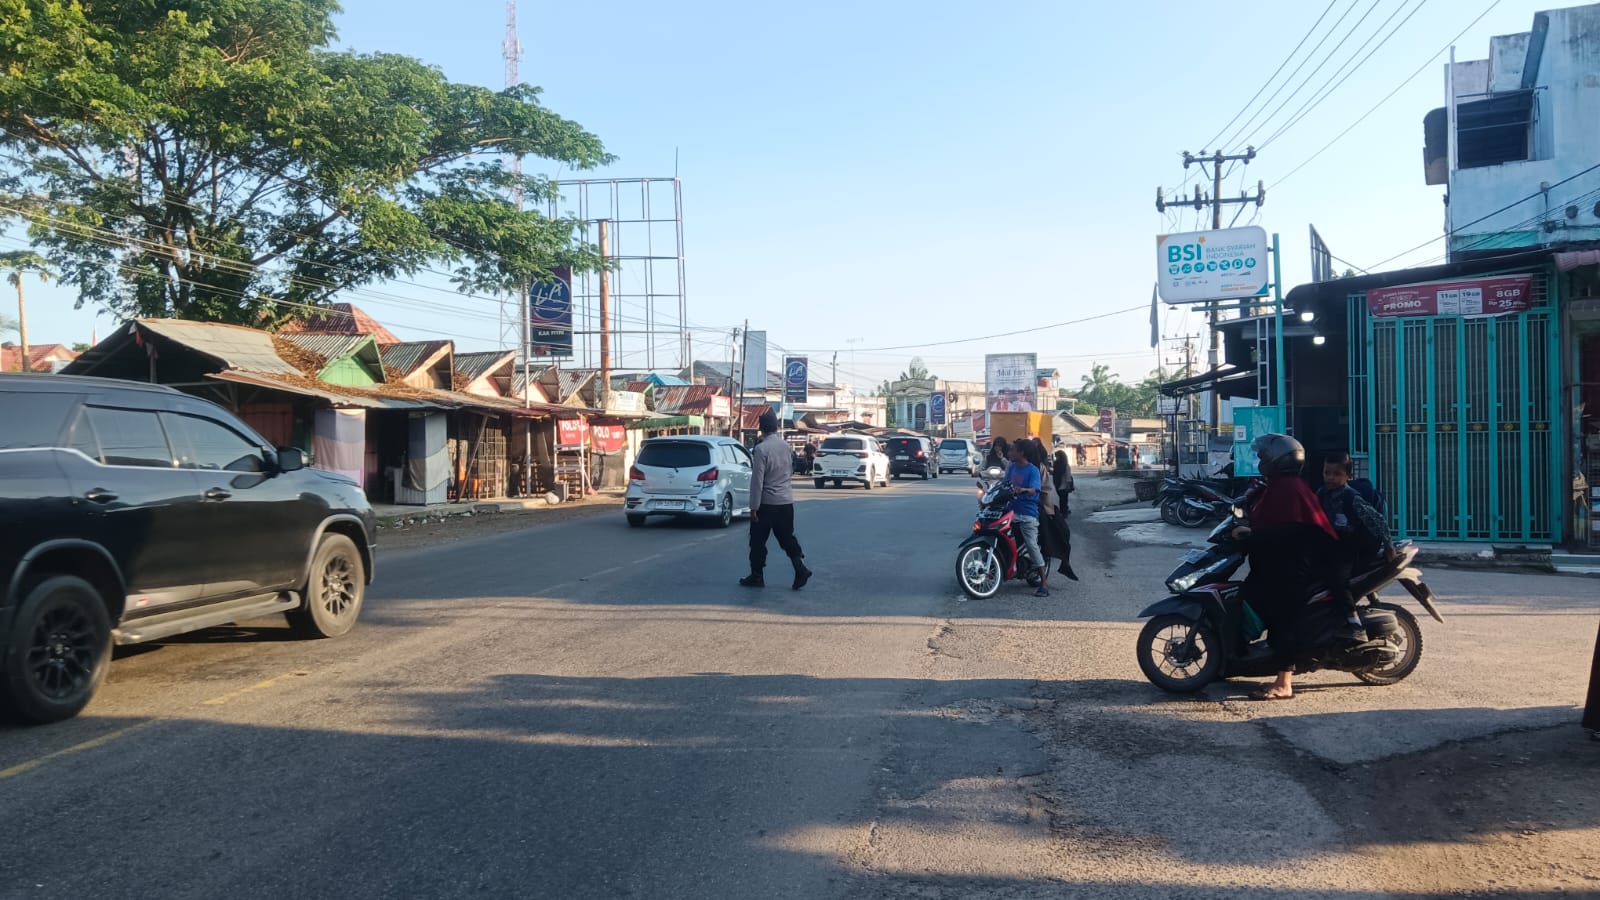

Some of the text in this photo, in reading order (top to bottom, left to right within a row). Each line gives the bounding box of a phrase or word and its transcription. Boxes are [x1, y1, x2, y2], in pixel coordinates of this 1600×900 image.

[1168, 243, 1202, 262] BSI
[1206, 246, 1226, 254] BANK
[1206, 251, 1245, 260] INDONESIA
[1496, 289, 1520, 297] 8GB
[1383, 300, 1422, 311] PROMO
